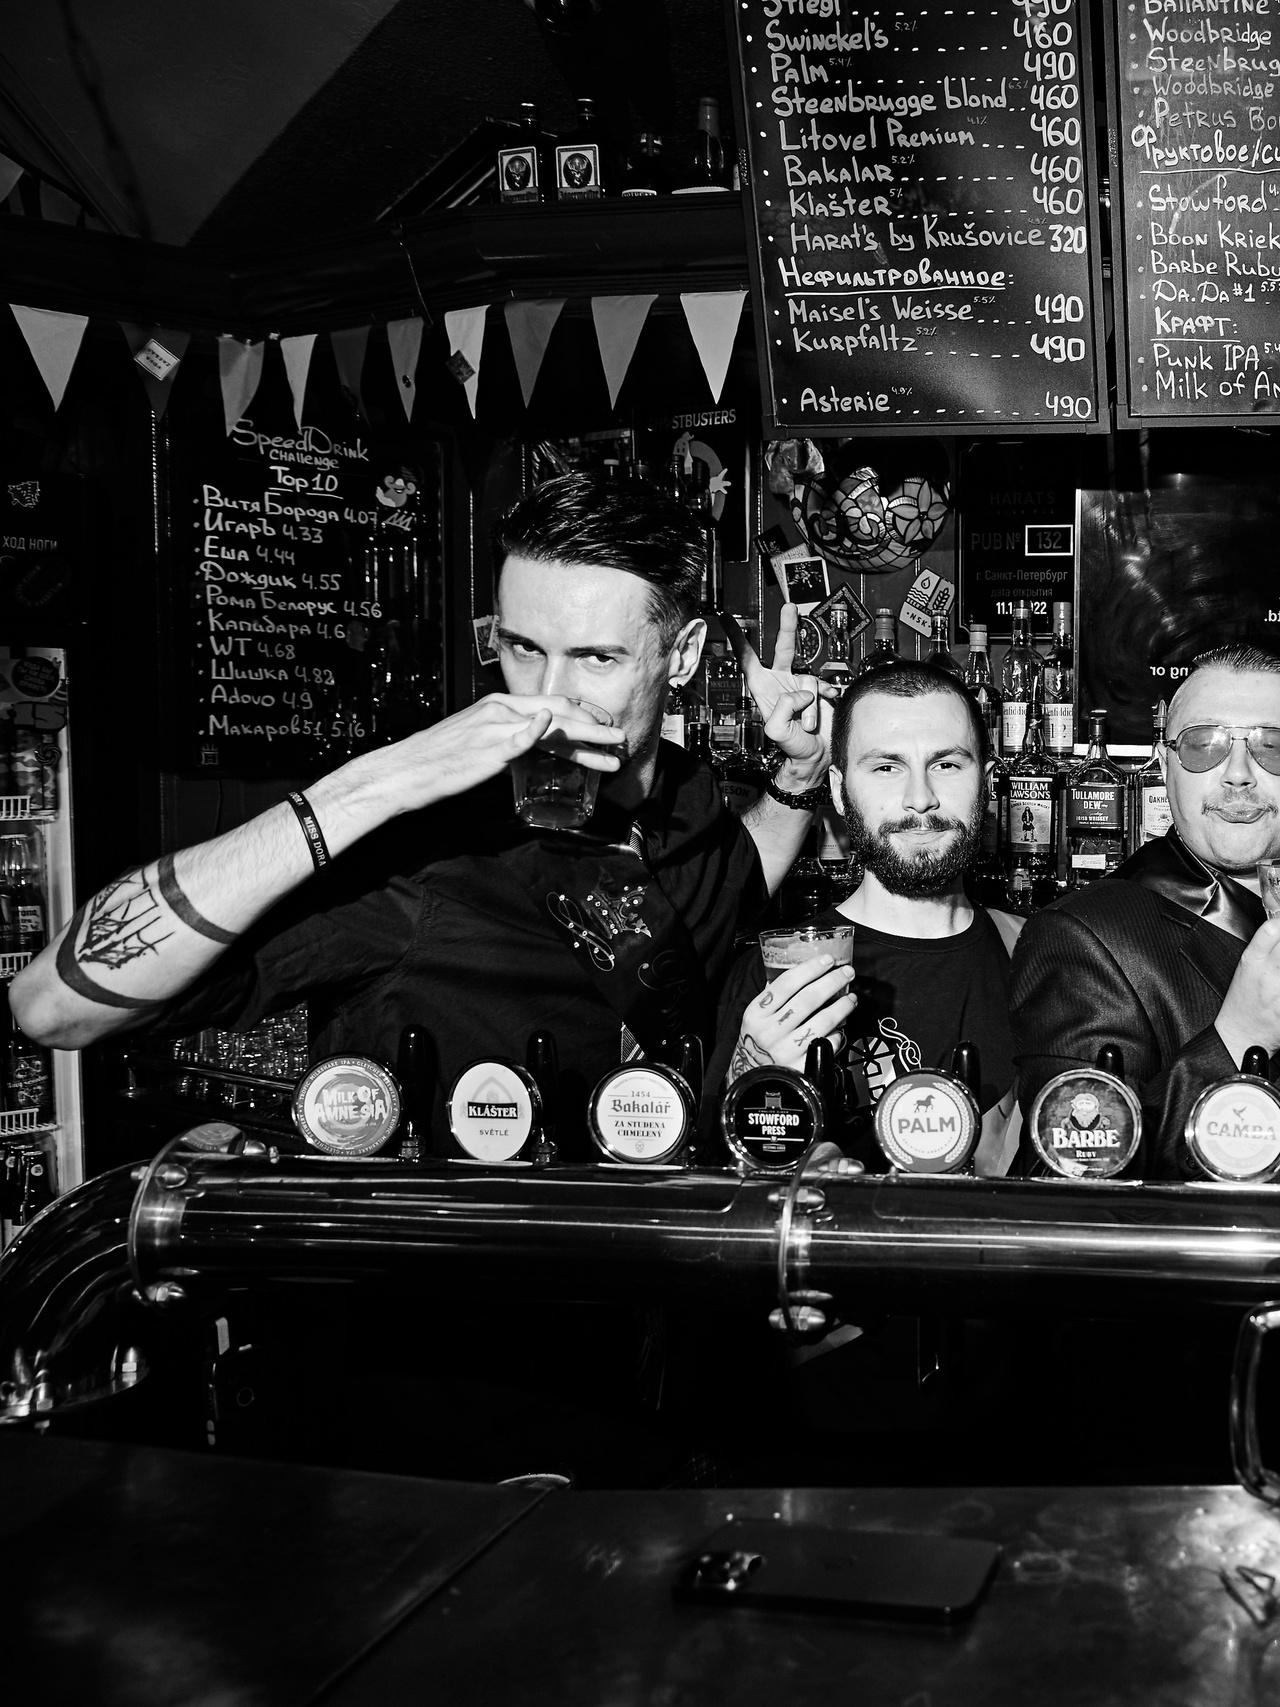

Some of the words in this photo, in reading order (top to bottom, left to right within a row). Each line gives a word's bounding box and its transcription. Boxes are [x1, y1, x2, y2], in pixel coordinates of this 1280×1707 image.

[765, 17, 889, 51] Swinckel's
[1013, 17, 1073, 48] 460
[1143, 18, 1272, 51] Woodbridge
[770, 53, 829, 84] Palm
[1024, 51, 1076, 81] 490
[771, 80, 937, 117] Steenbrugge
[944, 76, 1007, 109] blond
[1030, 84, 1079, 110] 460
[1153, 76, 1275, 99] Woodbridge
[1154, 98, 1237, 130] Petrus
[779, 116, 876, 151] Litovel
[886, 118, 975, 148] Premium
[1030, 113, 1081, 147] 460
[784, 155, 894, 187] Bakalar
[1029, 152, 1082, 184] 460
[789, 187, 893, 218] Klašter
[1033, 187, 1084, 215] 460
[1149, 175, 1268, 213] Stowford
[790, 222, 878, 253] Harat's
[889, 224, 914, 251] by
[923, 214, 1046, 248] Krušovice
[1049, 225, 1087, 253] 320
[1151, 222, 1208, 246] Boon
[778, 256, 1015, 290] Нефильтрованное:
[1151, 250, 1219, 275] Barbe
[788, 297, 880, 326] Maisel's
[892, 296, 974, 321] Weisse
[1034, 294, 1085, 323] 490
[793, 323, 919, 356] Kurpfaltz
[1030, 333, 1086, 362] 490
[1154, 345, 1214, 371] Punk
[1222, 345, 1260, 371] IPA
[1156, 372, 1208, 399] Milk
[1219, 375, 1246, 395] of
[801, 386, 891, 412] Asterie
[1045, 392, 1092, 418] 490
[269, 465, 309, 492] Top
[312, 473, 339, 492] 10
[203, 484, 261, 512] Витя
[264, 491, 340, 523] Борода
[344, 508, 378, 524] 4.07
[3, 536, 26, 550] ХОД
[282, 524, 323, 543] 4.33
[971, 532, 1003, 550] PUB
[1036, 531, 1063, 550] 132
[204, 536, 250, 561] Еша
[256, 545, 295, 565] 4.44
[200, 561, 297, 589] Дождик
[301, 573, 342, 591] 4.55
[984, 569, 1068, 585] Санкт-Петербург
[206, 584, 256, 609] Рома
[261, 591, 338, 617] Белорус
[990, 588, 1011, 598] дата
[1012, 587, 1053, 598] открытия
[208, 608, 312, 639] Капибара
[316, 622, 346, 639] 4.6
[210, 635, 252, 656] WT
[257, 642, 296, 659] 4.68
[211, 658, 289, 681] Шишка
[294, 665, 335, 685] 4.82
[282, 691, 313, 710] 4.9
[1010, 790, 1051, 800] LAWSON'S
[1011, 782, 1049, 791] WILLIAM
[1071, 788, 1115, 801] TULLAMORE
[304, 816, 319, 840] MISS
[314, 841, 327, 867] DORA
[468, 1105, 518, 1118] KLÁŠTER
[627, 1121, 666, 1129] STUDENA
[748, 1112, 800, 1127] STOWFORD
[761, 1125, 787, 1136] PRESS
[897, 1117, 957, 1135] PALM
[1051, 1128, 1122, 1150] BARBE
[1206, 1121, 1278, 1141] CAMBA
